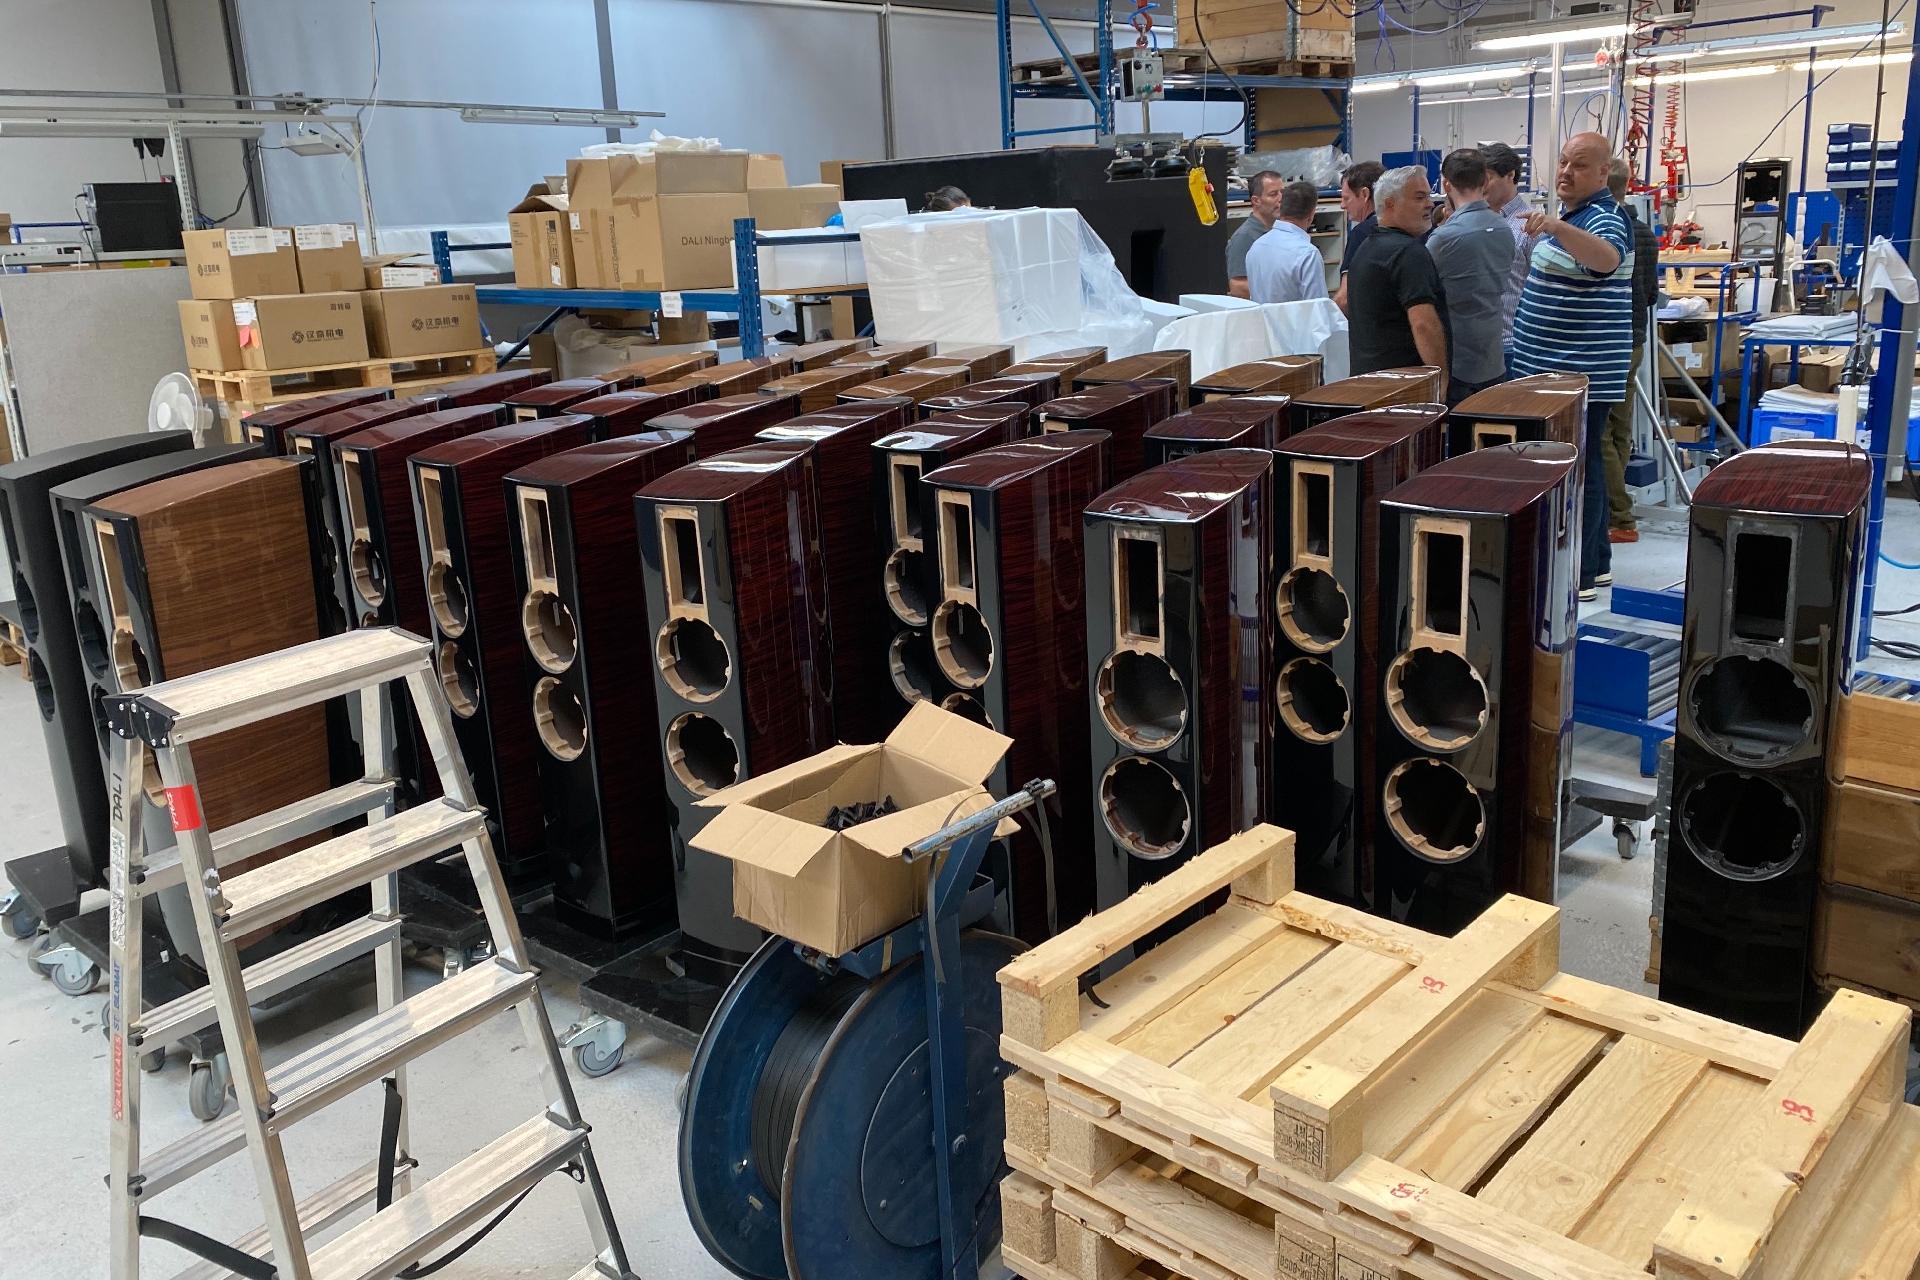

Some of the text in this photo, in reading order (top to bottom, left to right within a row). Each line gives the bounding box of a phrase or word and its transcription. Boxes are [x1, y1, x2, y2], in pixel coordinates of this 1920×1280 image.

[681, 236, 703, 246] DALI
[112, 773, 123, 822] DALI
[113, 1036, 123, 1108] BAUHAUS
